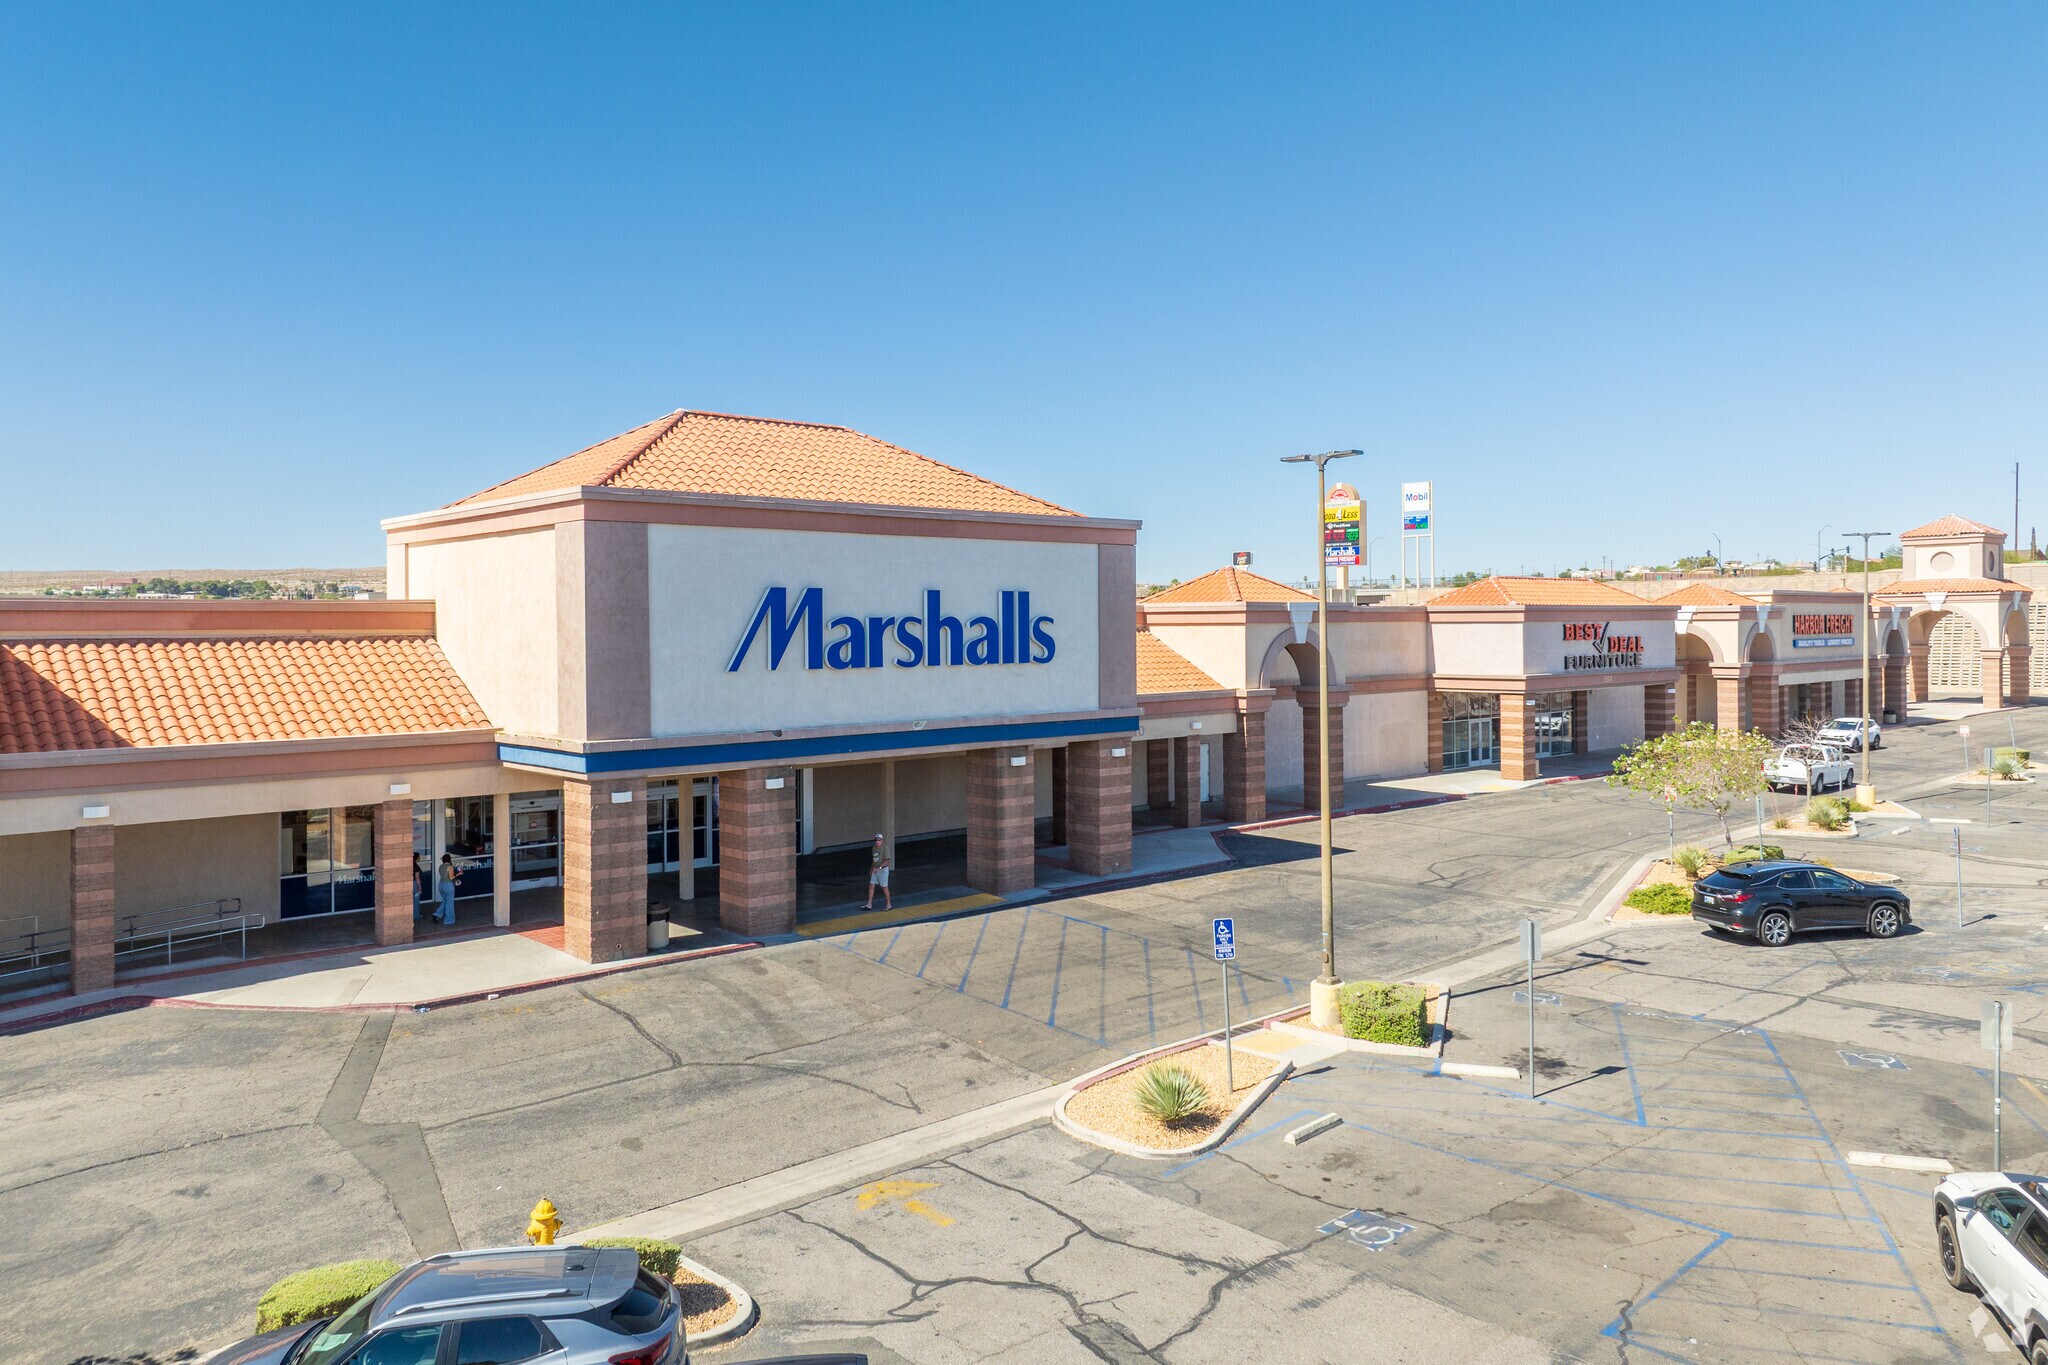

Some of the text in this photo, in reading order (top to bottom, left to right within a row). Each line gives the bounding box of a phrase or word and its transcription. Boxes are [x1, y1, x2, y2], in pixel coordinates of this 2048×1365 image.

[1406, 492, 1428, 501] Mobil
[1336, 508, 1343, 520] 4
[1325, 546, 1355, 556] Marshalls
[725, 586, 1056, 672] Marshalls
[1794, 614, 1855, 635] HARBOR FREIGHT
[1563, 623, 1644, 653] BEST DEAL
[1564, 653, 1643, 670] FURNITURE
[334, 872, 375, 885] Marshal
